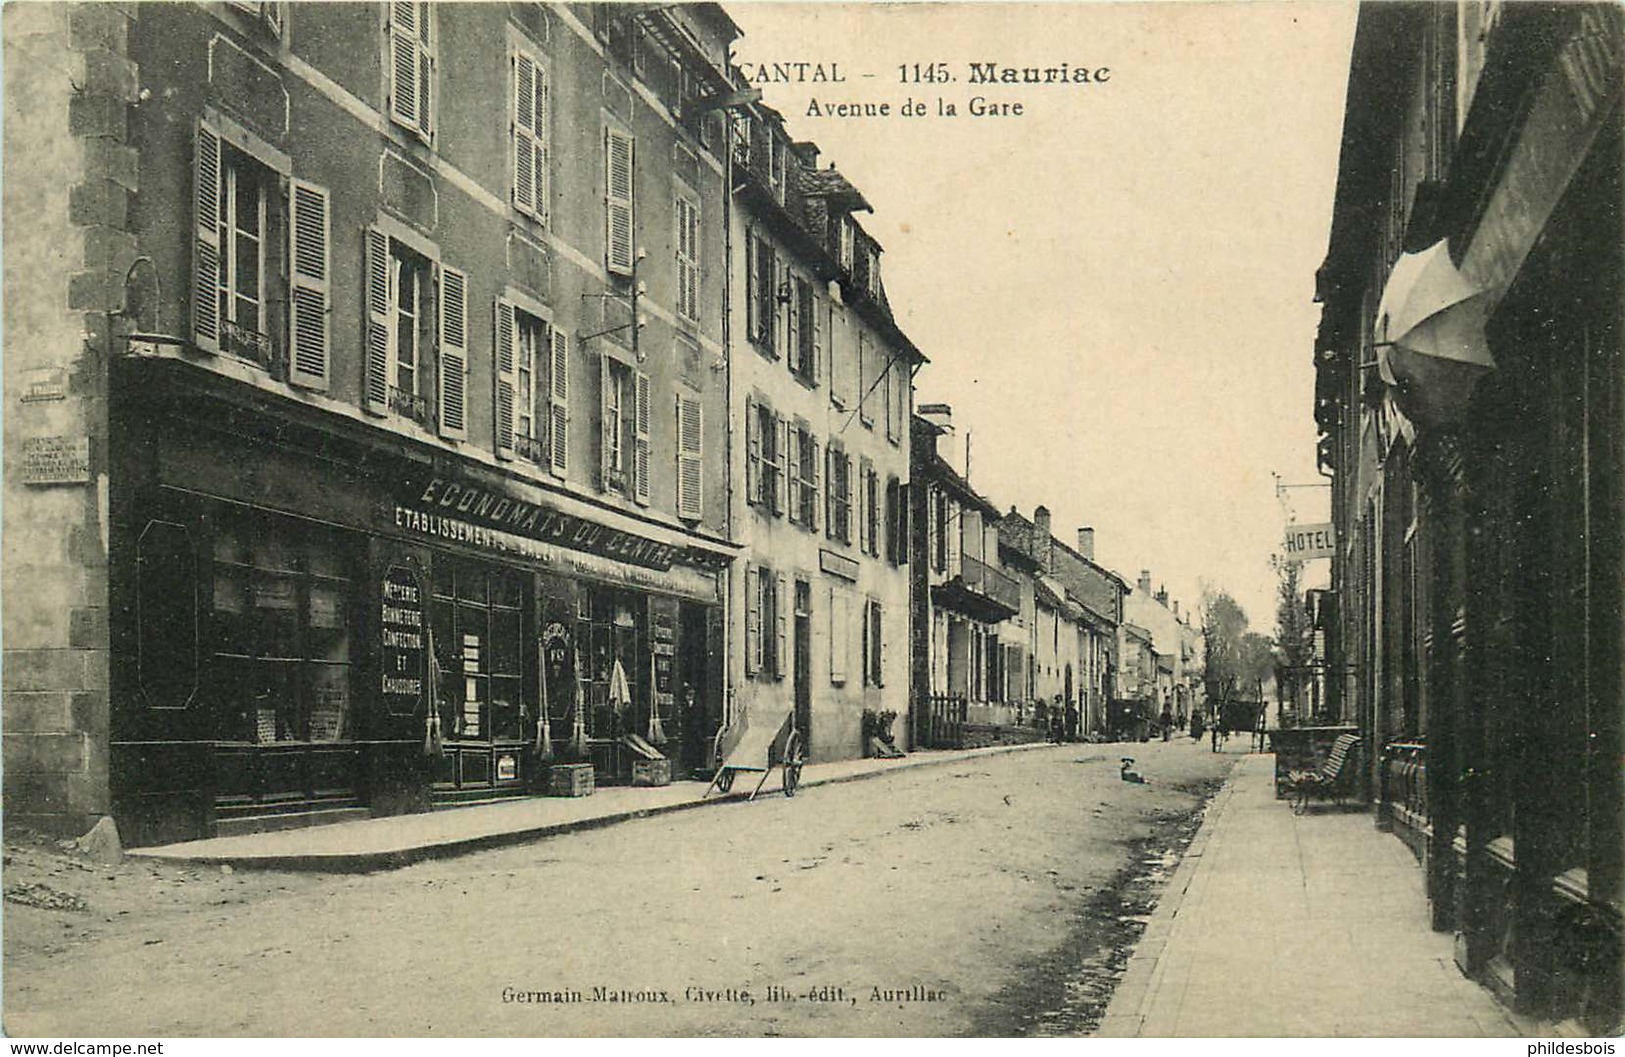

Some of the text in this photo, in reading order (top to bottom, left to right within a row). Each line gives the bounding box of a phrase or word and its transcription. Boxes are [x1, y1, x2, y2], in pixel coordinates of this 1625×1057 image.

[395, 506, 507, 551] ETABLISSEMENTS
[421, 478, 674, 565] ECONOMATS DU CENTRE
[1286, 531, 1334, 552] HOTEL
[397, 655, 407, 671] ET
